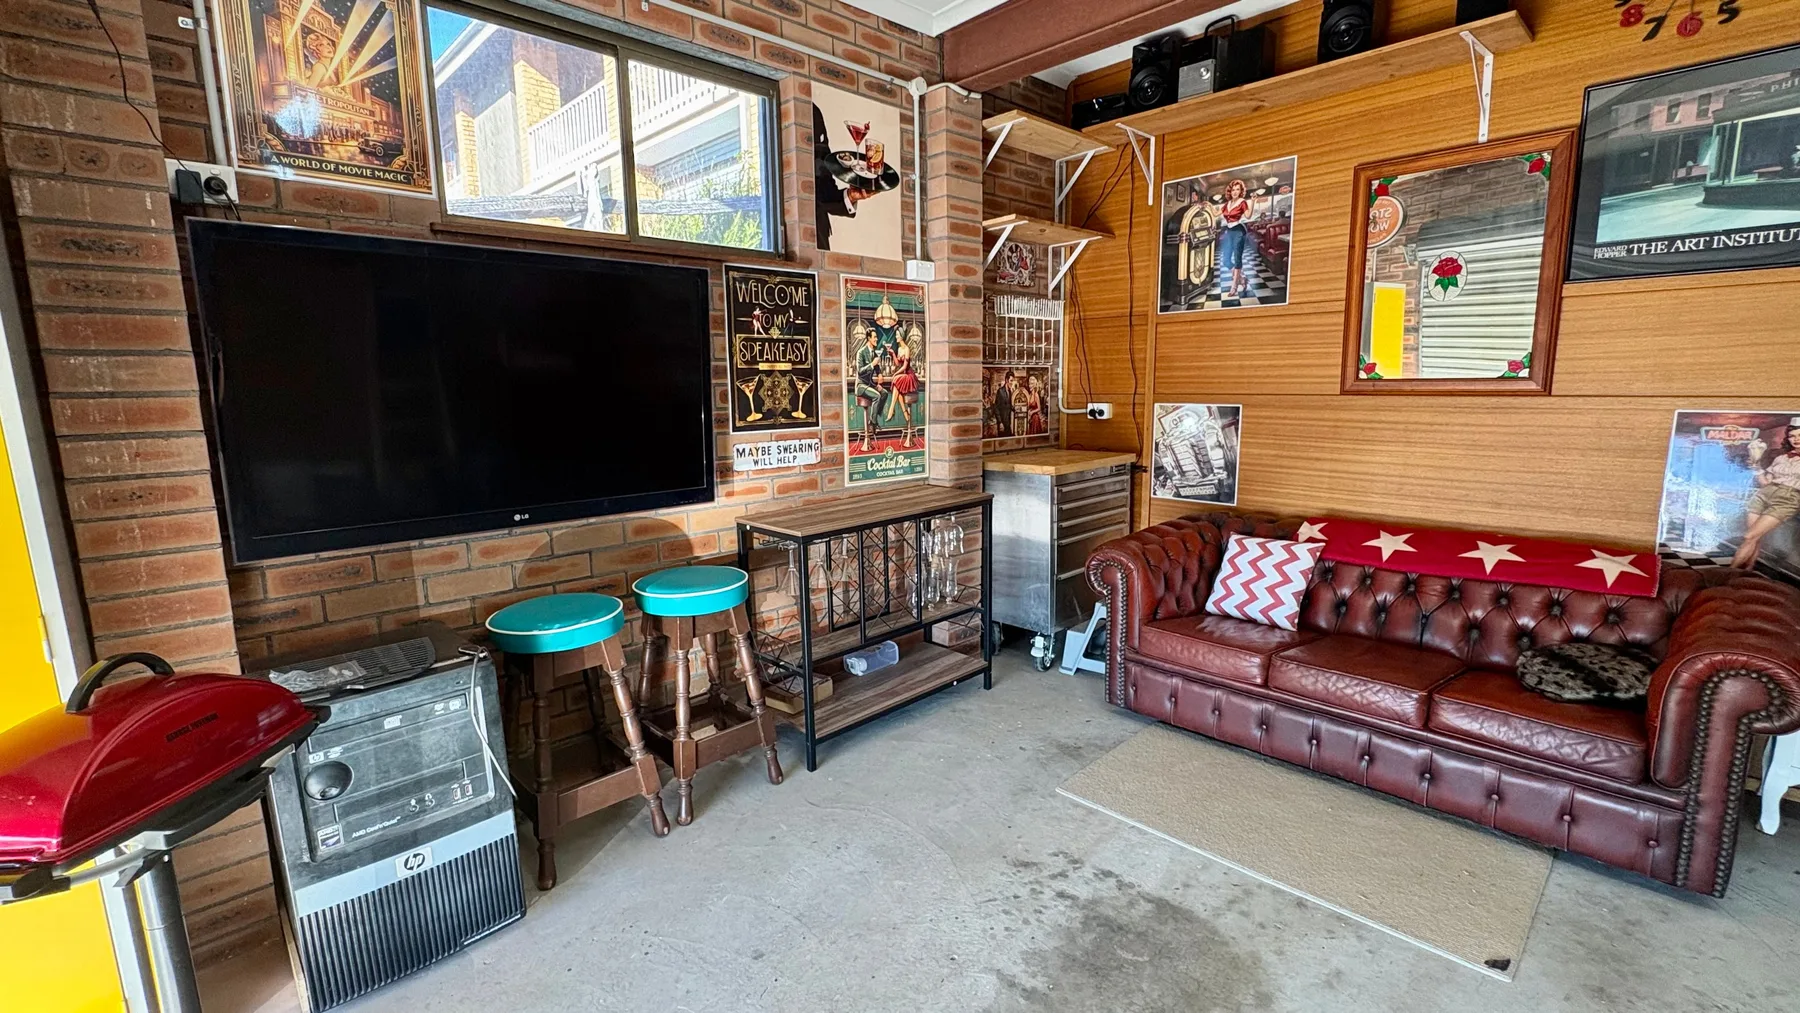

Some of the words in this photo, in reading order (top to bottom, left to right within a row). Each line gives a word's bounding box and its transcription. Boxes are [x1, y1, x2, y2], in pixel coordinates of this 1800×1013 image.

[1620, 4, 1645, 27] 8
[1717, 0, 1740, 24] 5
[1642, 14, 1668, 41] 7
[1676, 11, 1704, 37] 6
[311, 93, 369, 115] ETROPOLITAN
[270, 155, 279, 163] A
[280, 156, 320, 169] WORLD
[322, 162, 336, 171] OF
[339, 165, 373, 177] MOVIE
[374, 170, 408, 182] MAGIC
[1593, 251, 1627, 259] HOPPER
[1595, 245, 1628, 253] EDWARD
[1629, 241, 1668, 256] THE
[1670, 237, 1709, 252] ART
[736, 280, 809, 308] WELCOME
[759, 313, 772, 328] TO
[774, 313, 789, 328] MY
[740, 341, 807, 361] SPEAKEASY
[736, 446, 772, 458] MAYBE
[777, 442, 819, 455] SWEARING
[753, 458, 773, 467] WILL
[777, 455, 797, 465] HELP
[897, 455, 911, 468] Bar
[404, 853, 425, 871] hp
